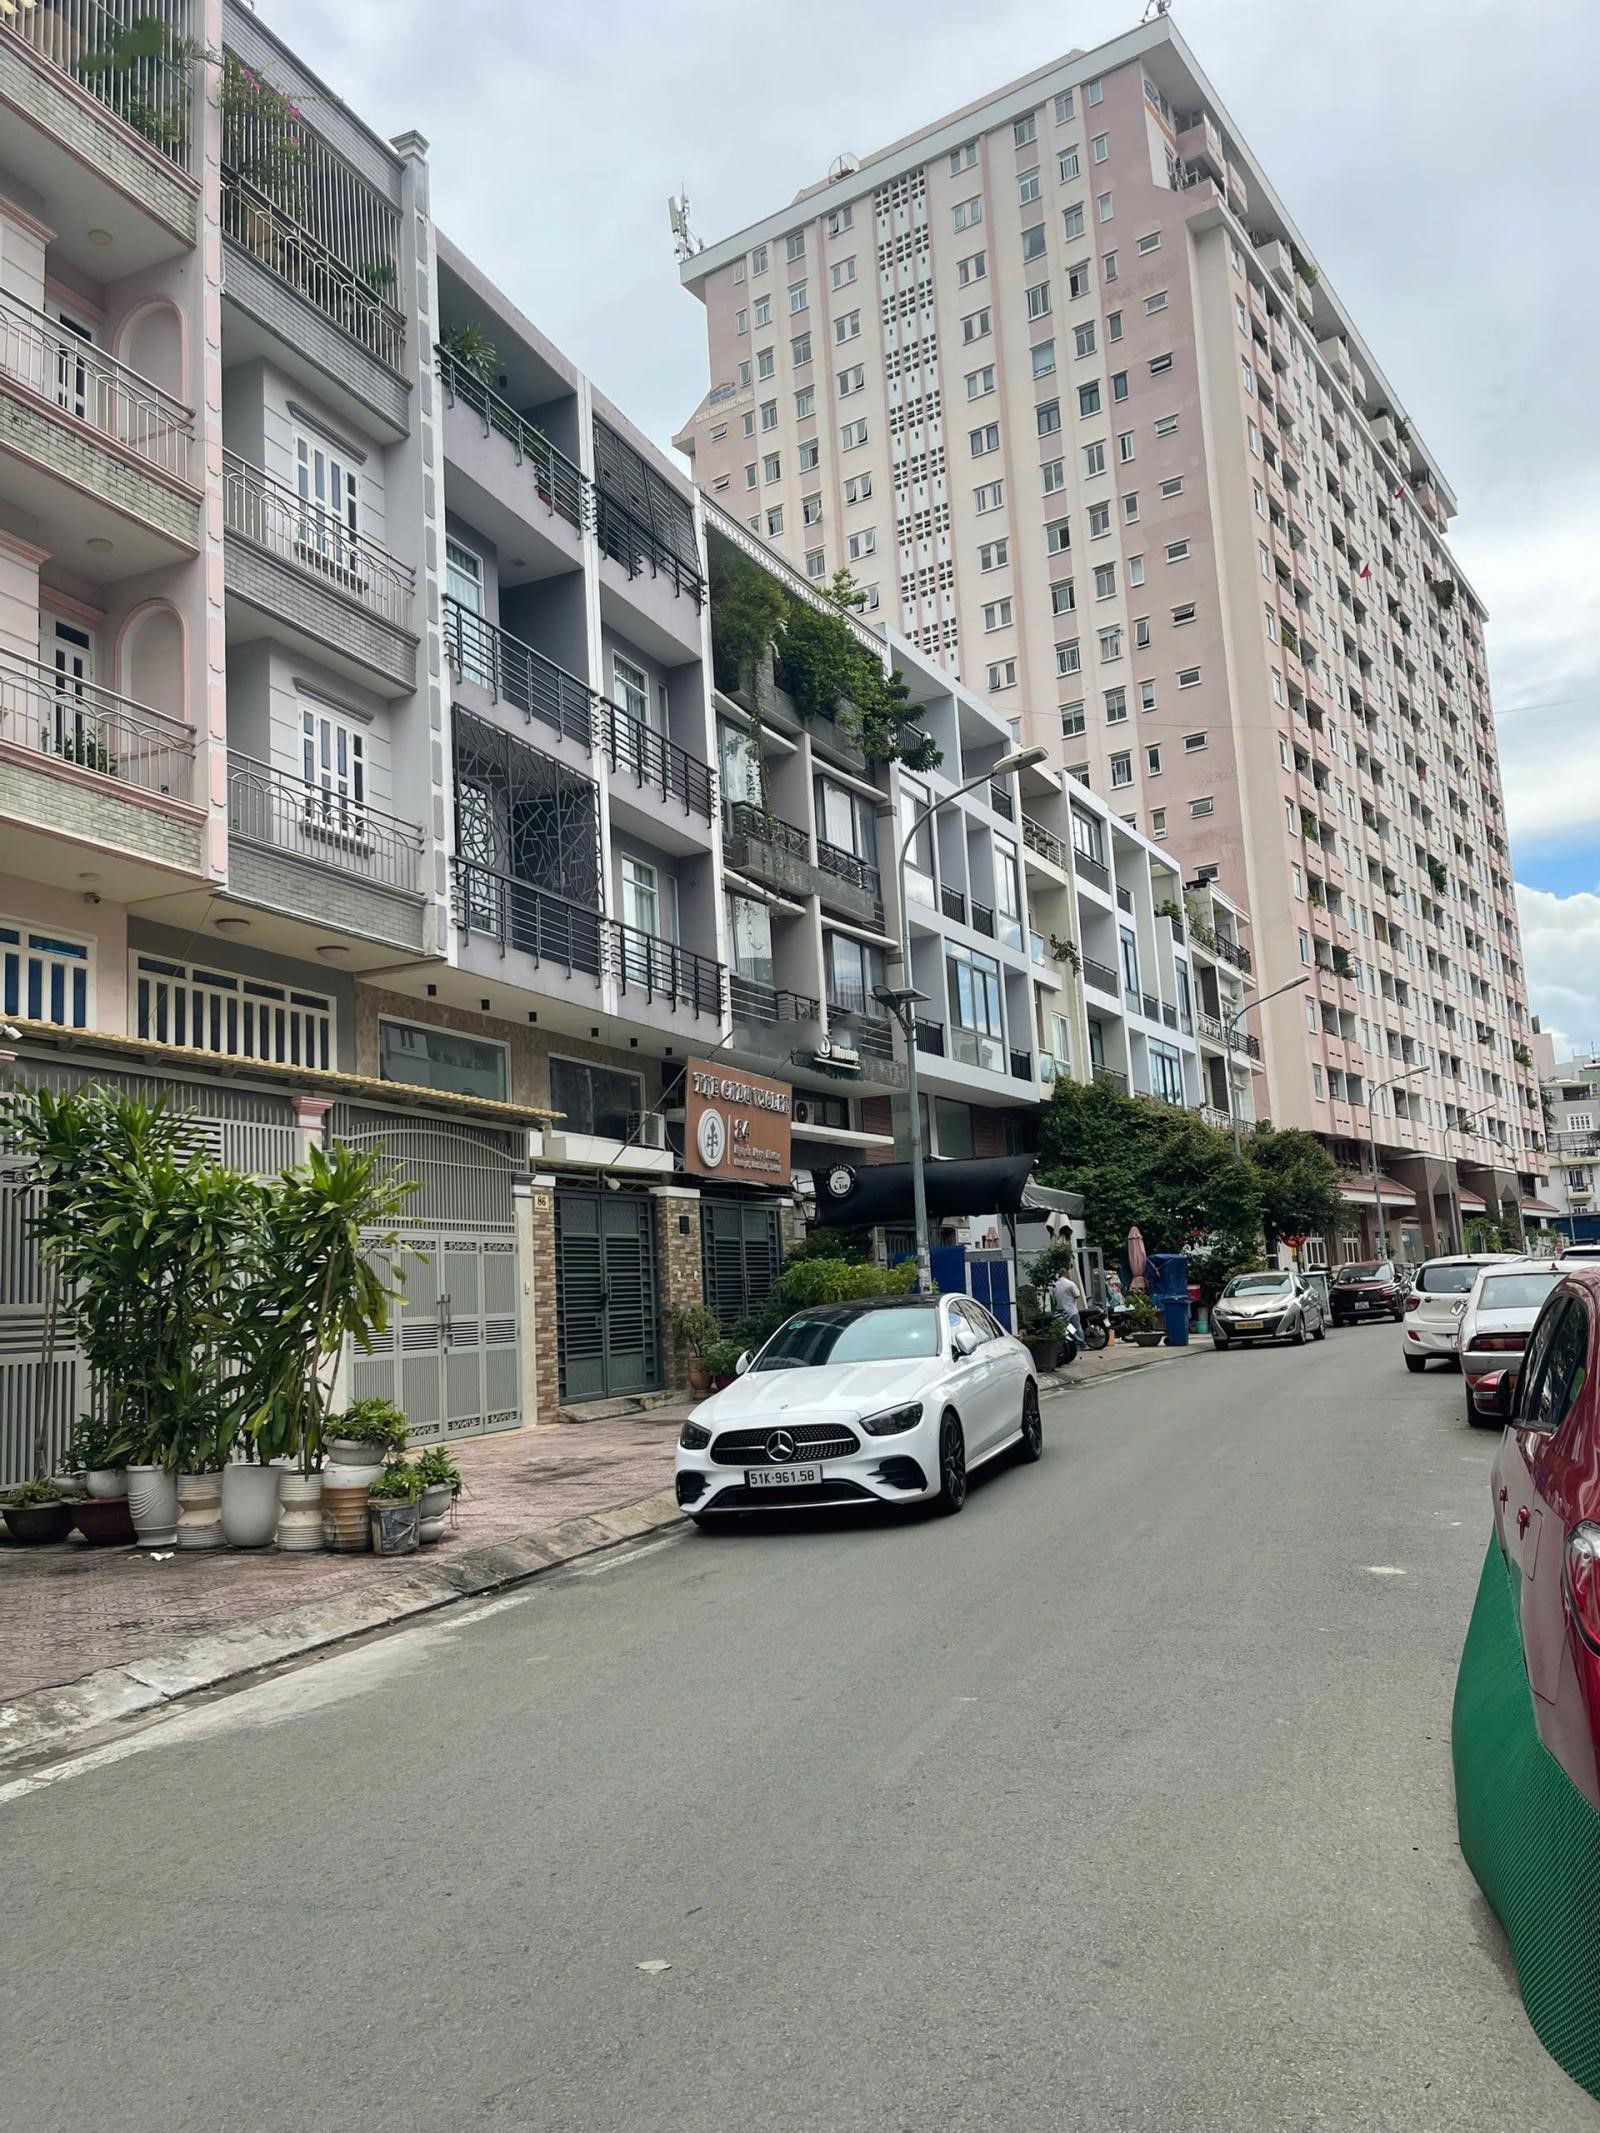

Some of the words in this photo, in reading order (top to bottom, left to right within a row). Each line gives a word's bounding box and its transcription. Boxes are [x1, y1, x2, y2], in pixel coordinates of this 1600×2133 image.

[734, 1119, 750, 1142] 84
[537, 1195, 547, 1206] 86
[750, 1469, 815, 1485] 51K-961.58
